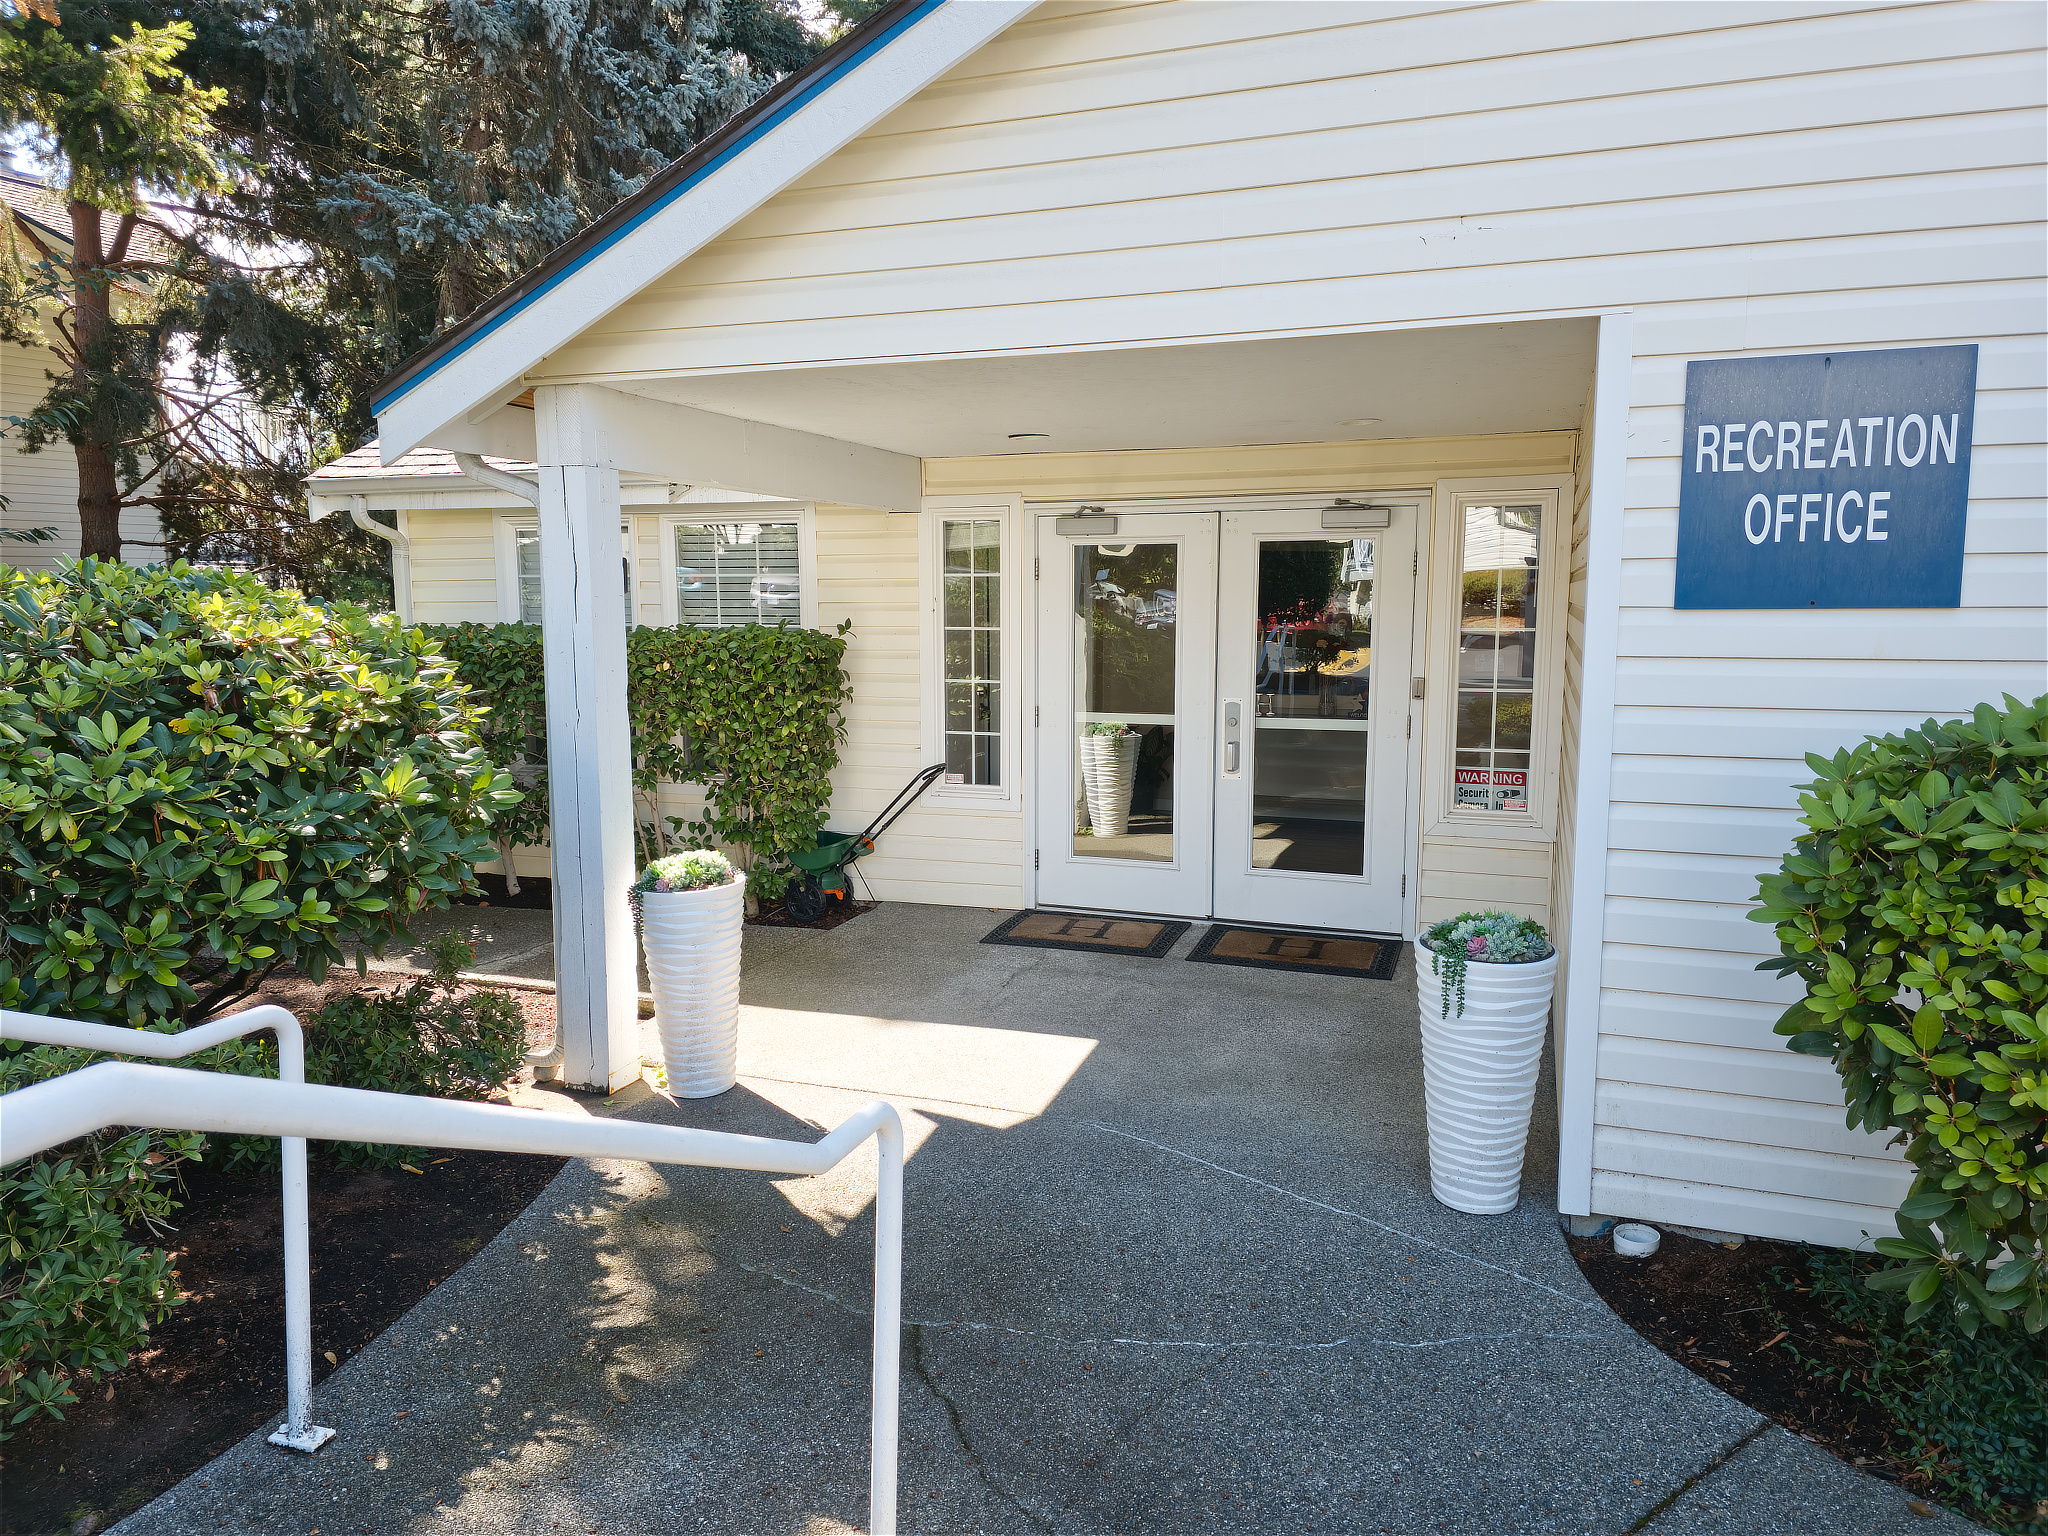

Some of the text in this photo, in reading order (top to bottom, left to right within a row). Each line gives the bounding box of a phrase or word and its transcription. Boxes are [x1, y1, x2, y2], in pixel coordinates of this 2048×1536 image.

[1695, 413, 1959, 473] RECREATION
[1744, 490, 1891, 545] OFFICE
[1458, 771, 1523, 784] WARNING
[1458, 787, 1494, 798] Securit
[1049, 918, 1123, 939] H
[1258, 936, 1337, 959] H
